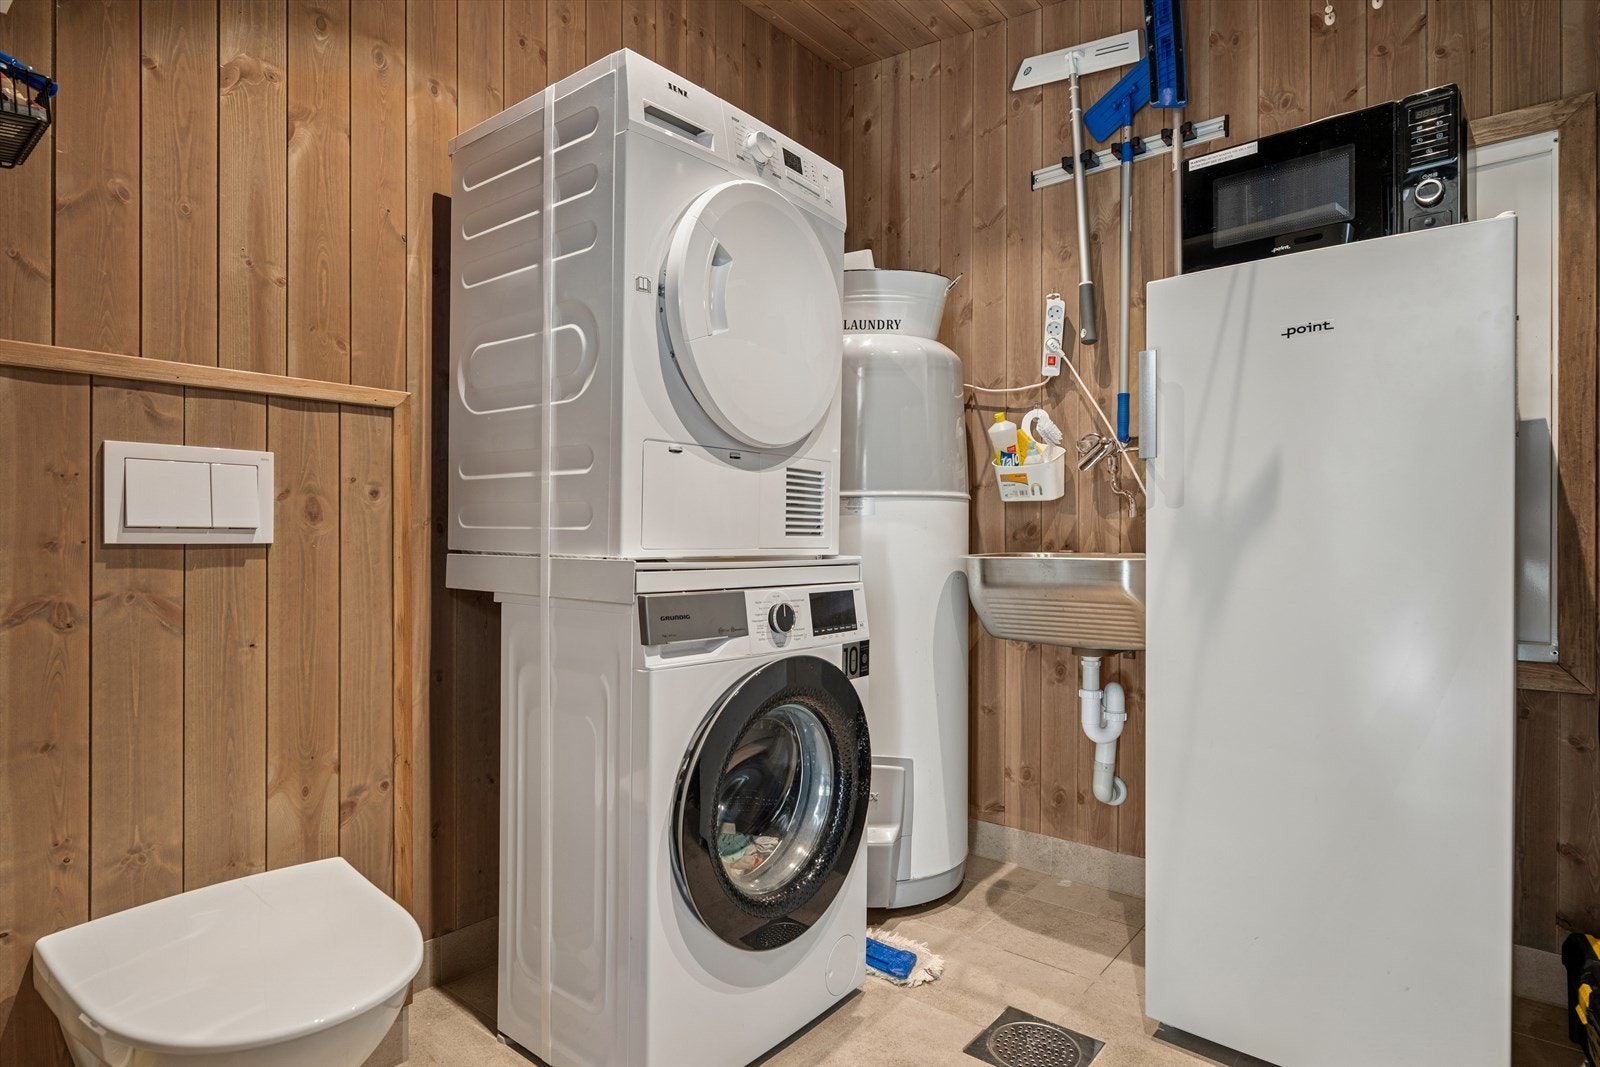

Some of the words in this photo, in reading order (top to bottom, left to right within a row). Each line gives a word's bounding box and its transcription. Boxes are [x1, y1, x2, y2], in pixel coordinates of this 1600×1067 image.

[1271, 245, 1291, 253] point
[843, 319, 901, 330] LAUNDRY
[1281, 321, 1334, 339] point
